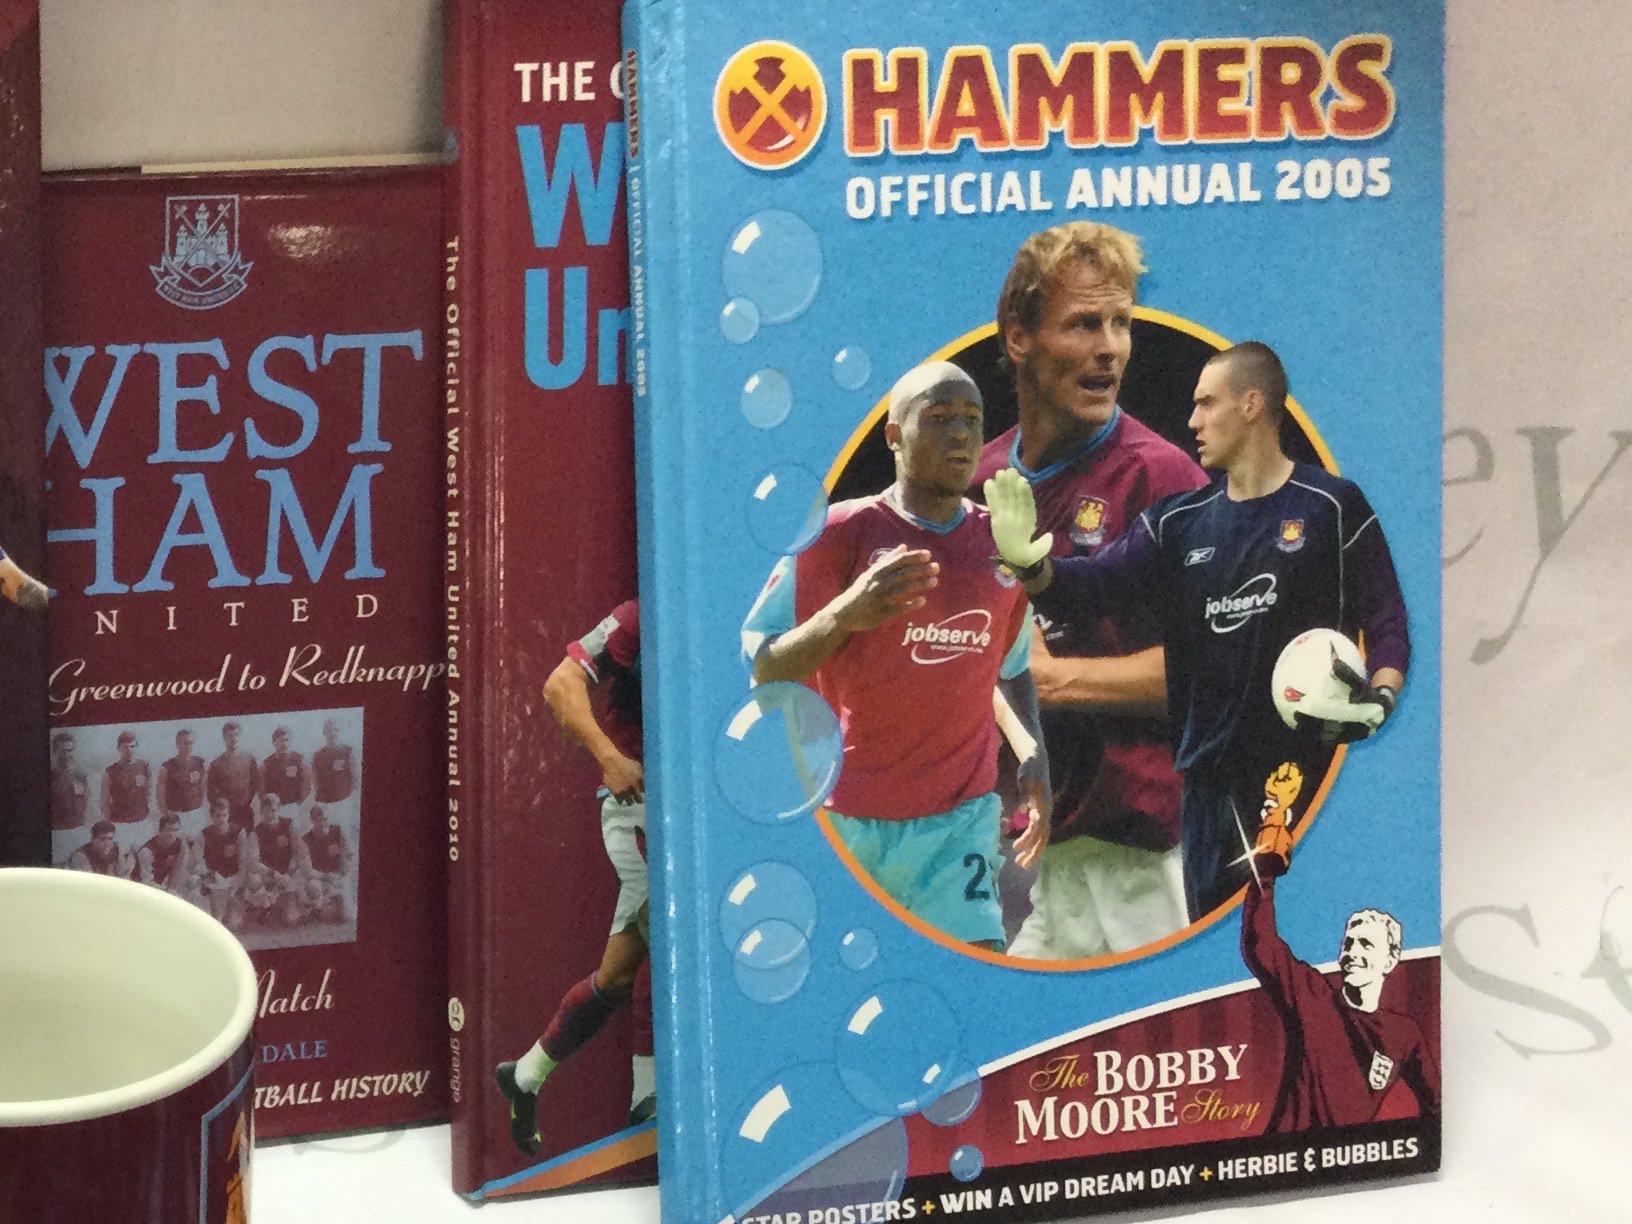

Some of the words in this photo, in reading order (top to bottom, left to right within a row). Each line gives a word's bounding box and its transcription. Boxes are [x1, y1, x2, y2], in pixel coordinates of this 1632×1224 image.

[514, 61, 596, 102] THE
[842, 33, 1395, 158] HAMMERS
[845, 167, 1052, 219] OFFICIAL
[1067, 162, 1261, 211] ANNUAL
[1275, 157, 1391, 200] 2005
[446, 236, 461, 292] The
[447, 304, 460, 415] Official
[447, 427, 460, 498] West
[446, 511, 460, 574] Ham
[95, 590, 379, 634] NITED
[446, 585, 460, 679] United
[902, 622, 991, 646] jobserve
[1205, 592, 1277, 619] jobserve
[48, 653, 231, 716] Greenwood
[238, 663, 266, 692] to
[279, 643, 446, 692] Redknapp
[447, 690, 461, 788] Annual
[448, 798, 460, 862] 2010
[262, 1040, 328, 1064] DALE
[1029, 1055, 1089, 1091] The
[1094, 1044, 1248, 1095] BOBBY
[254, 1075, 323, 1109] TBALL
[331, 1070, 430, 1101] HISTORY
[1015, 1092, 1178, 1145] MOORE
[1181, 1090, 1260, 1130] Story
[939, 1189, 992, 1214] WIN
[998, 1185, 1015, 1207] A
[1019, 1179, 1058, 1204] VIP
[1064, 1169, 1144, 1199] DREAM
[1151, 1164, 1195, 1189] DAY
[1217, 1151, 1297, 1182] HERBIE
[1321, 1137, 1419, 1168] BUBBLES
